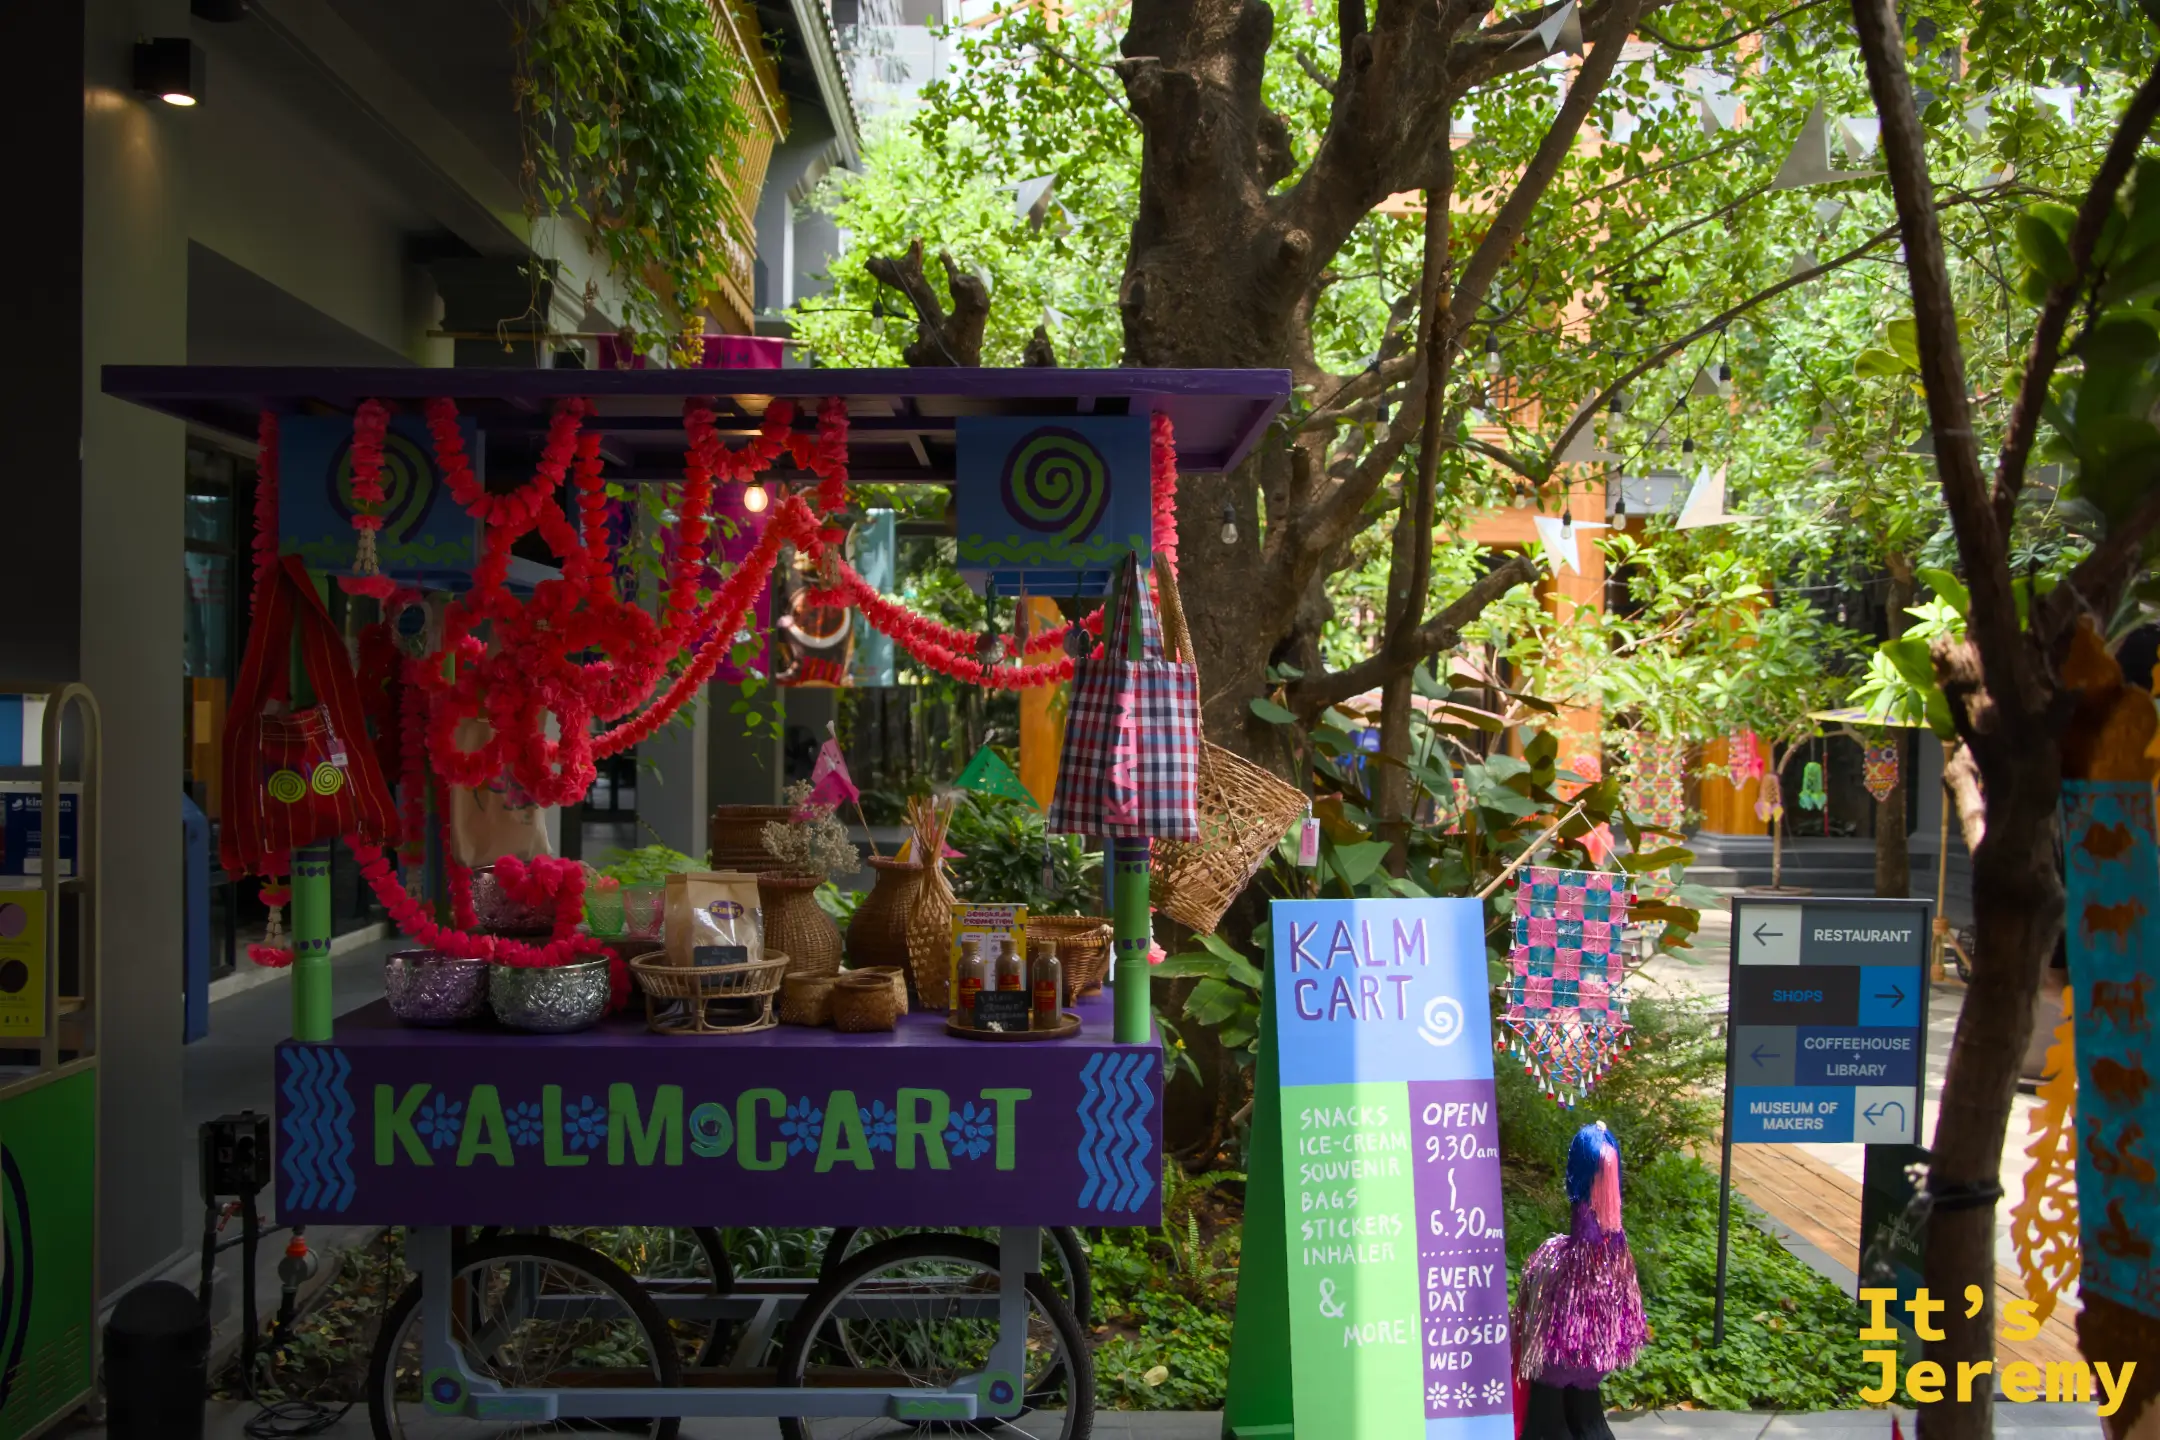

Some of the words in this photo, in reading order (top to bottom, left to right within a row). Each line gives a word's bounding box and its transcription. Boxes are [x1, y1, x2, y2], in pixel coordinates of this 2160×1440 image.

[1103, 692, 1138, 825] KALM
[25, 796, 72, 807] kinm
[1289, 917, 1430, 973] KALM
[1813, 928, 1912, 944] RESTAURANT
[1294, 975, 1414, 1022] CART
[1772, 989, 1824, 1003] SHOPS
[1804, 1036, 1911, 1052] COFFEEHOUSE
[1826, 1062, 1887, 1078] LIBRARY
[1299, 1106, 1388, 1131] SNACKS
[1422, 1102, 1489, 1129] OPEN
[1749, 1101, 1813, 1115] MUSEUM
[1817, 1101, 1838, 1115] OF
[374, 1082, 685, 1168] KALM
[736, 1086, 1033, 1173] CART
[1763, 1116, 1824, 1131] MAKERS
[1299, 1131, 1407, 1156] ICE-CREAM
[1299, 1156, 1402, 1186] SOUVENIR
[1301, 1187, 1359, 1213] BAGS
[1301, 1212, 1403, 1242] STICKERS
[1303, 1243, 1396, 1266] INHALER
[1426, 1264, 1495, 1290] EVERY
[1319, 1277, 1346, 1319] &
[1428, 1290, 1467, 1313] DAY
[1343, 1314, 1417, 1349] MORE!
[1427, 1323, 1508, 1348] CLOSED
[1429, 1351, 1473, 1372] WED
